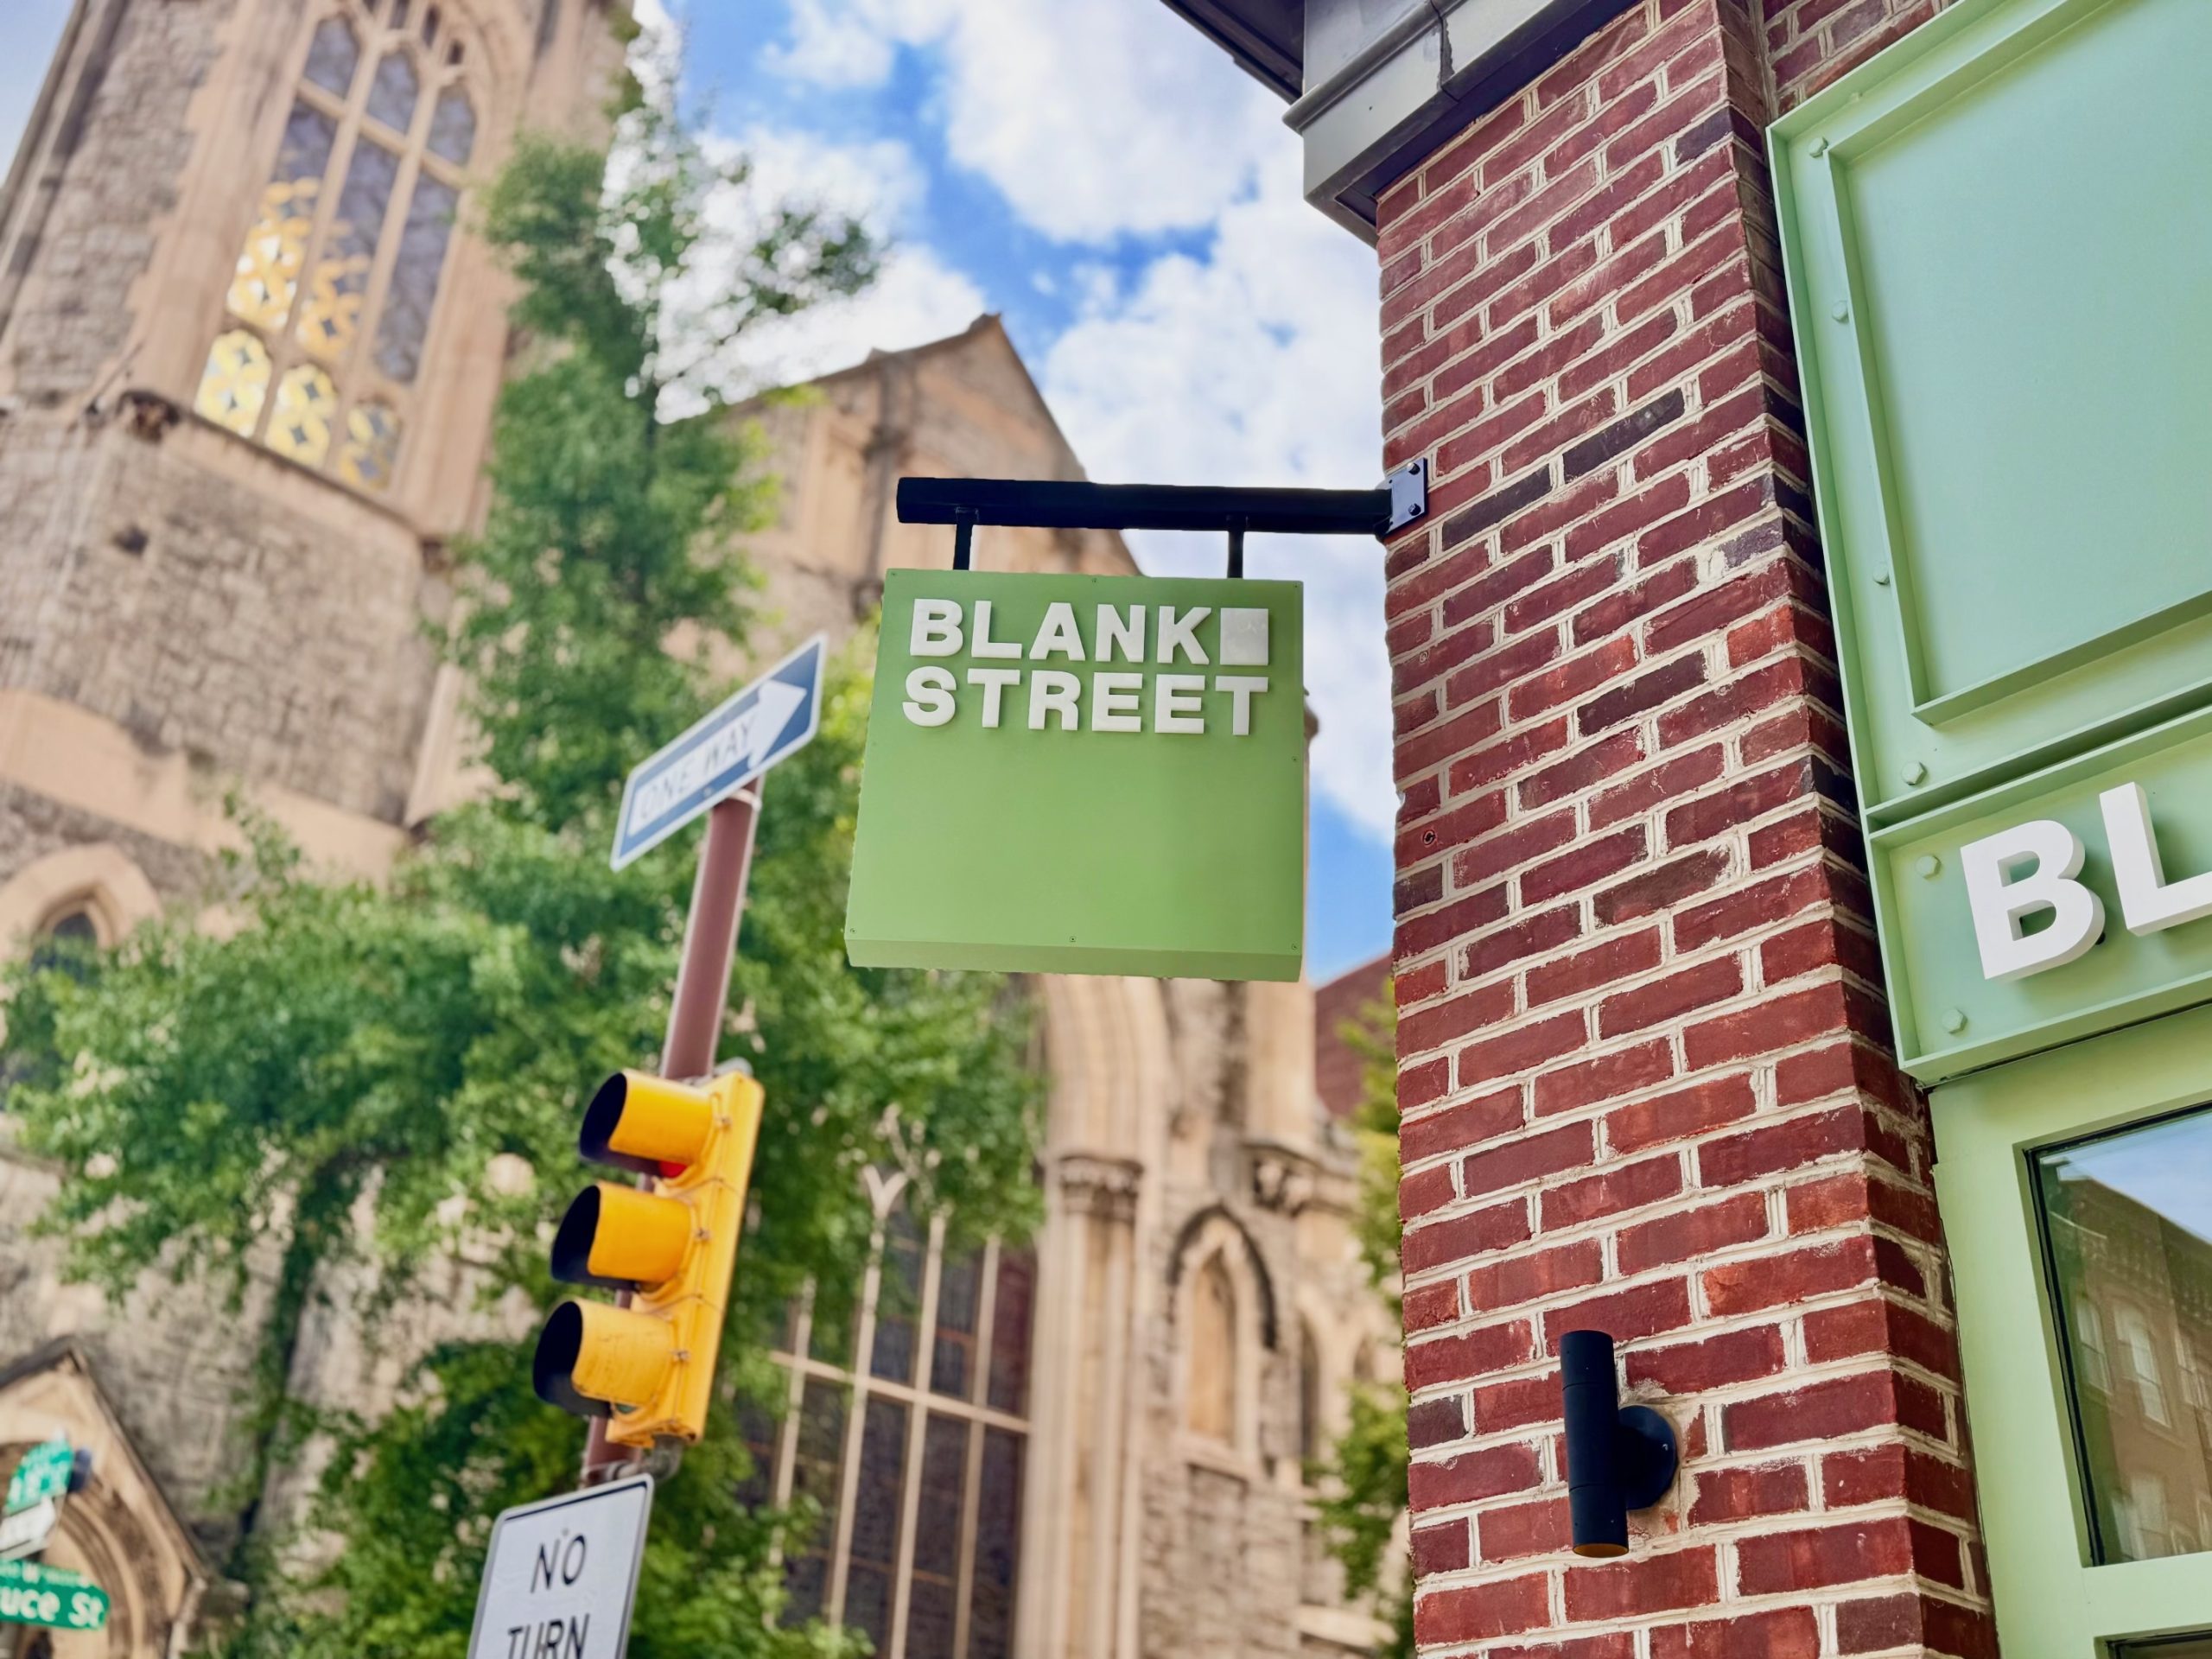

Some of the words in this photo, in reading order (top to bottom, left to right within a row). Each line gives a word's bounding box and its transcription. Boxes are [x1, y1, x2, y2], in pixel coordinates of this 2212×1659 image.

[910, 597, 1211, 665] BLANK
[902, 665, 1268, 736] STREET
[639, 754, 696, 823] ONE
[702, 710, 757, 776] WAY
[529, 1533, 587, 1594] NO
[0, 1586, 61, 1623] uce
[68, 1591, 105, 1629] St
[507, 1612, 591, 1659] TURN
